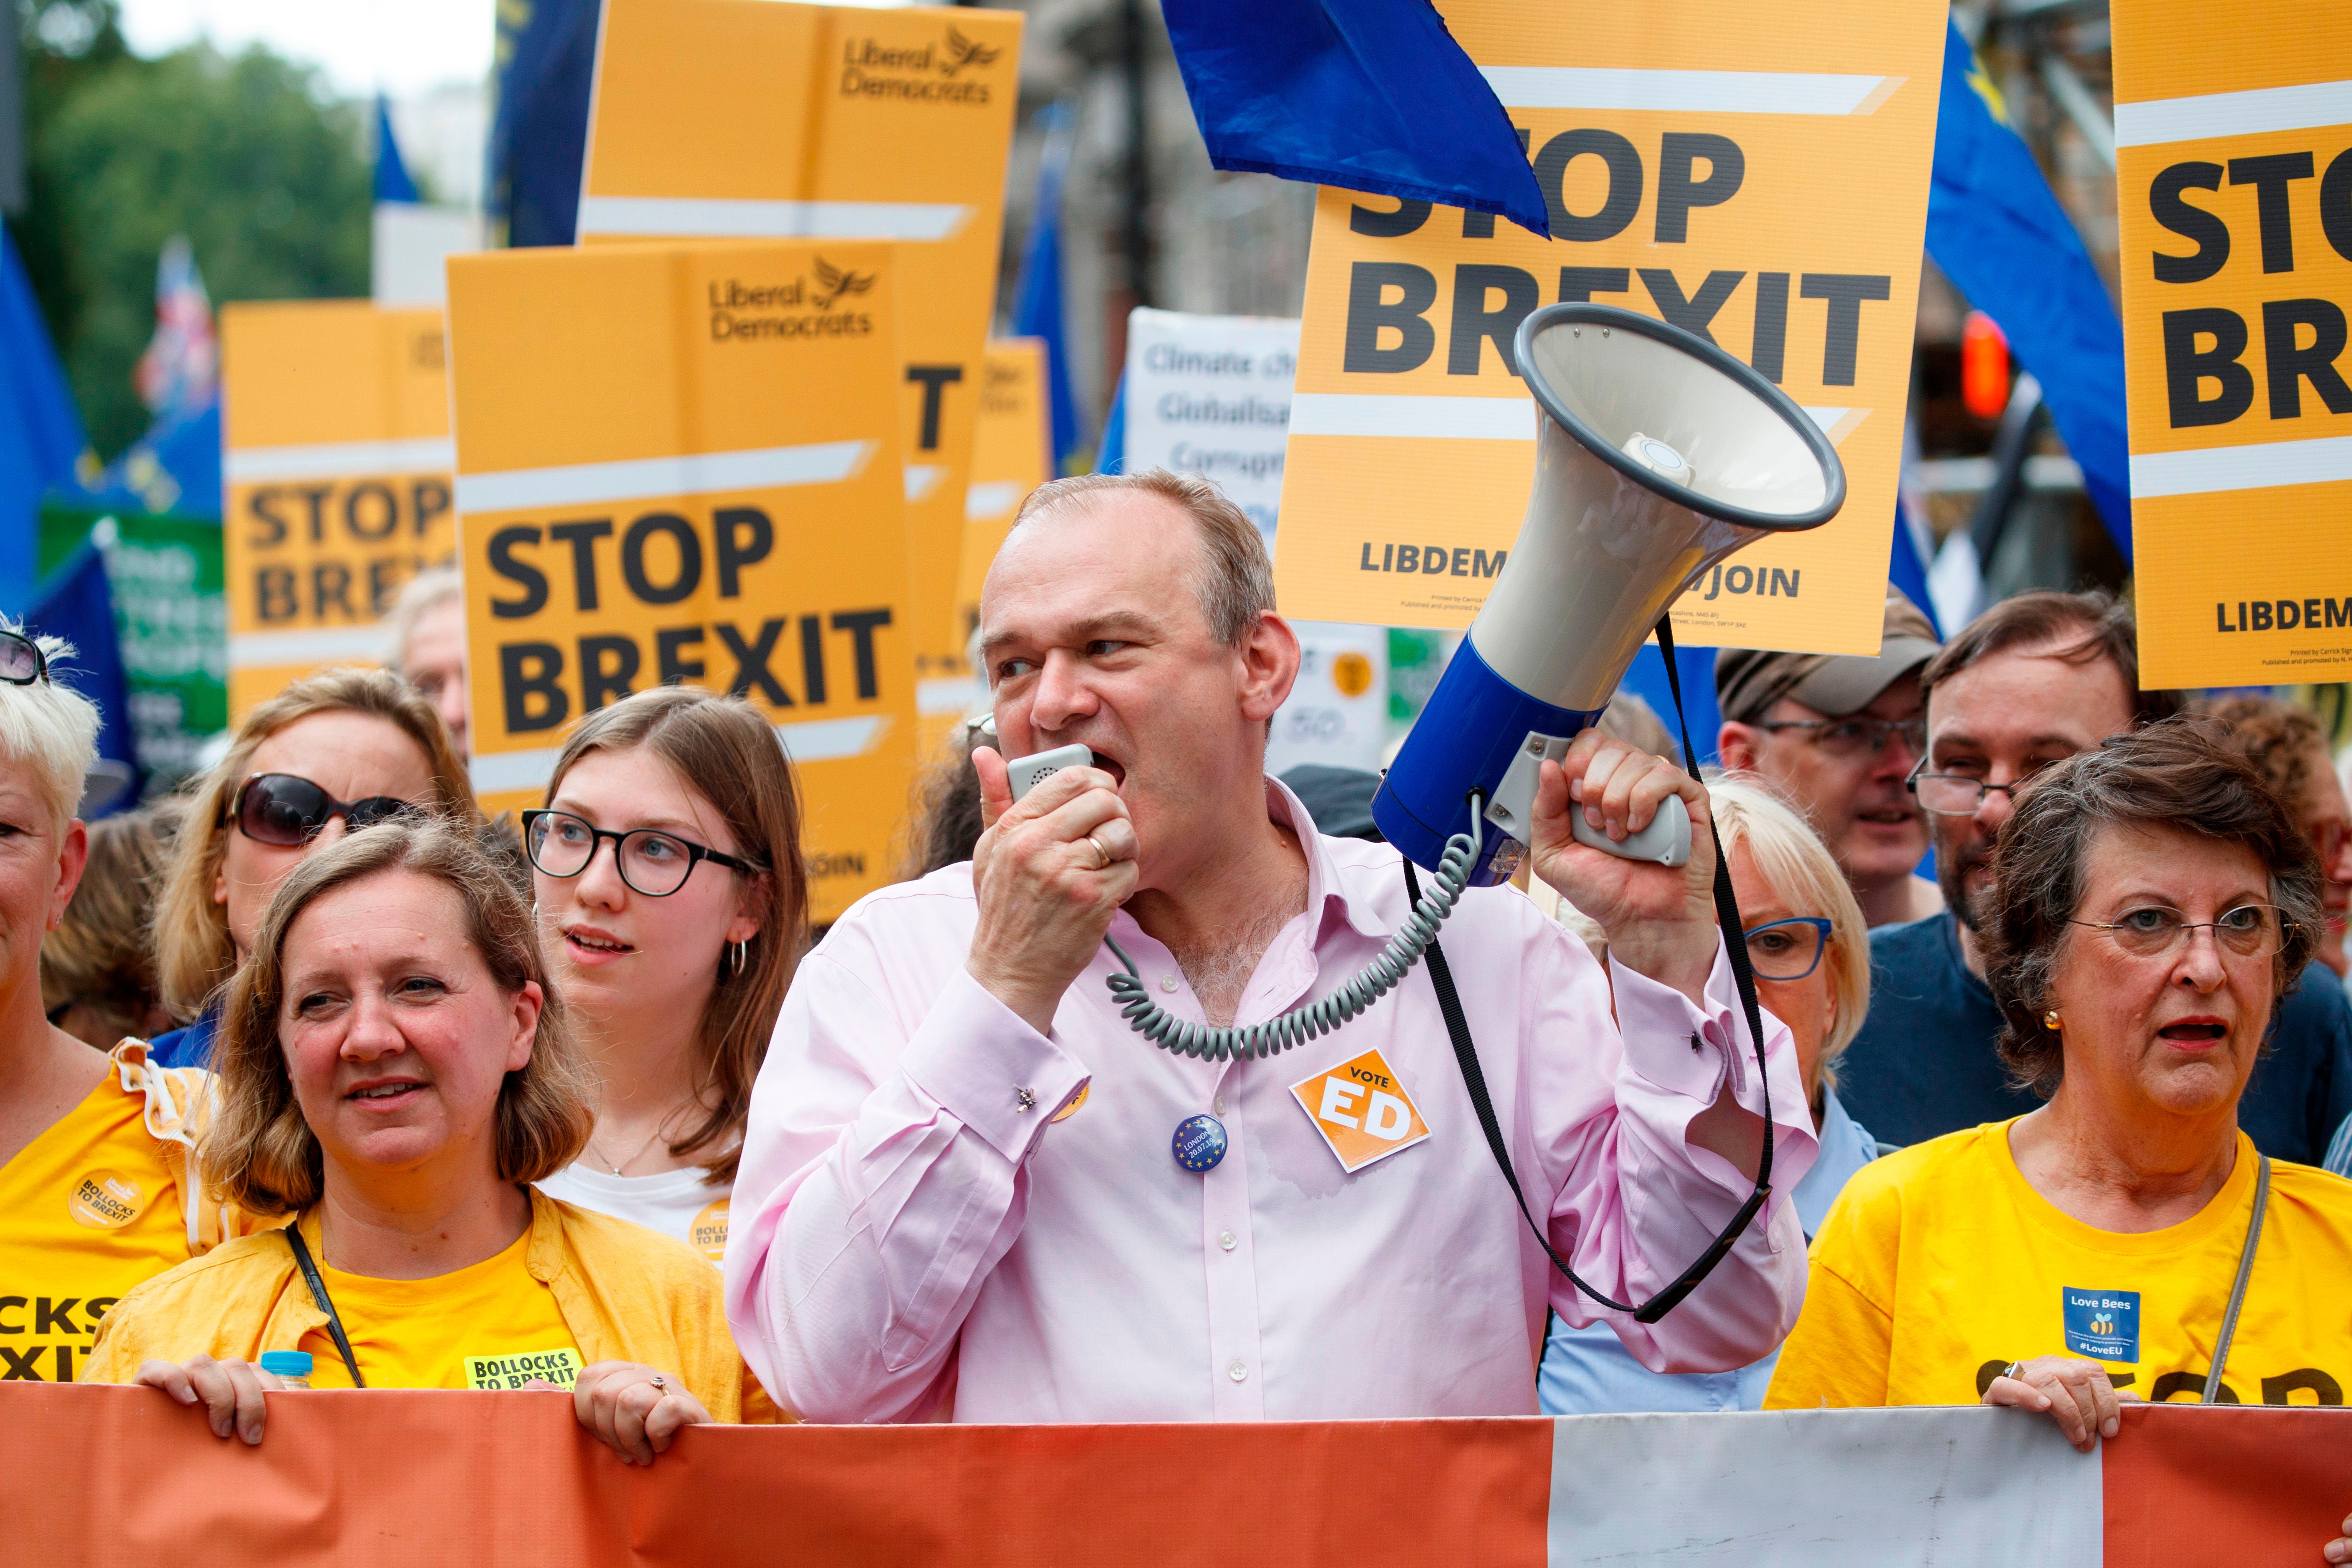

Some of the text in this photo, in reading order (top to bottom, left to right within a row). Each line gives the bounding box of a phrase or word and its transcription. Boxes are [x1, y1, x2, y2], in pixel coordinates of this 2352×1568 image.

[844, 37, 935, 70] Liberal
[709, 275, 805, 308] Liberal
[711, 310, 873, 343] Democrats
[2162, 298, 2352, 428] BR
[248, 478, 450, 550] STOP
[487, 505, 774, 619] STOP
[2217, 597, 2352, 632] LIBDEM
[1350, 1066, 1389, 1088] VOTE
[1319, 1076, 1411, 1141] ED
[1184, 1129, 1210, 1151] LONDON
[1189, 1137, 1214, 1158] 20.07.19
[77, 1187, 92, 1201] TO
[91, 1199, 128, 1221] BREXIT
[83, 1179, 136, 1216] BOLLOCKS
[696, 1226, 728, 1236] BOLL
[697, 1236, 711, 1245] TO
[2071, 1296, 2131, 1310] Love Bees
[474, 1353, 569, 1378] BOLLOCKS
[2080, 1343, 2122, 1355] #LoveEU
